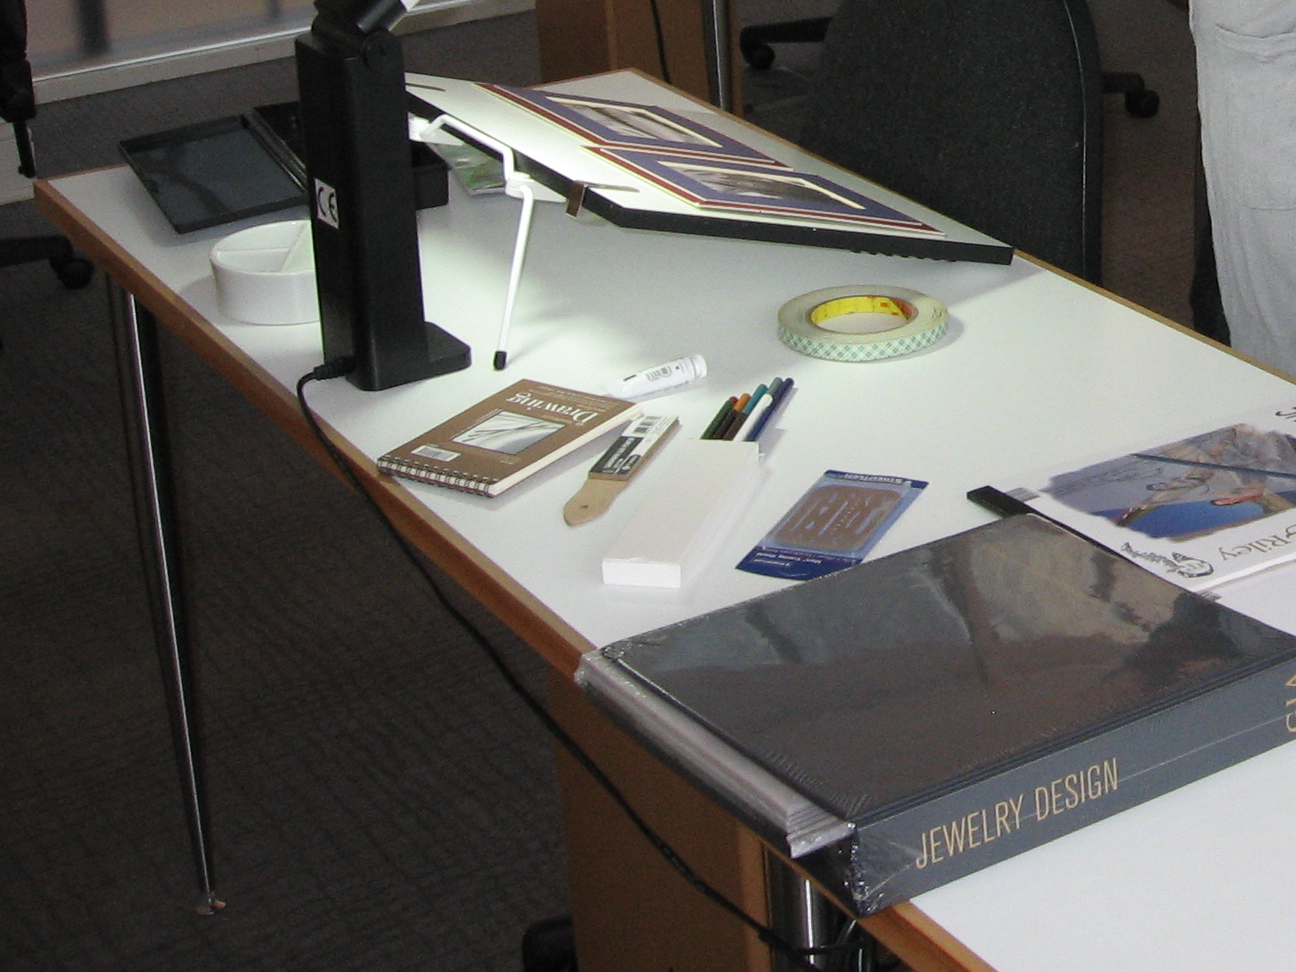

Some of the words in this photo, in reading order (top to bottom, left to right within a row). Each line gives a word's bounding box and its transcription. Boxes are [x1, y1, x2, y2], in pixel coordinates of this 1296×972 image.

[318, 186, 338, 223] CE
[505, 391, 599, 425] Drawing
[1218, 534, 1294, 561] Riley
[916, 794, 1025, 870] JEWELRY
[1035, 758, 1119, 822] DESIGN
